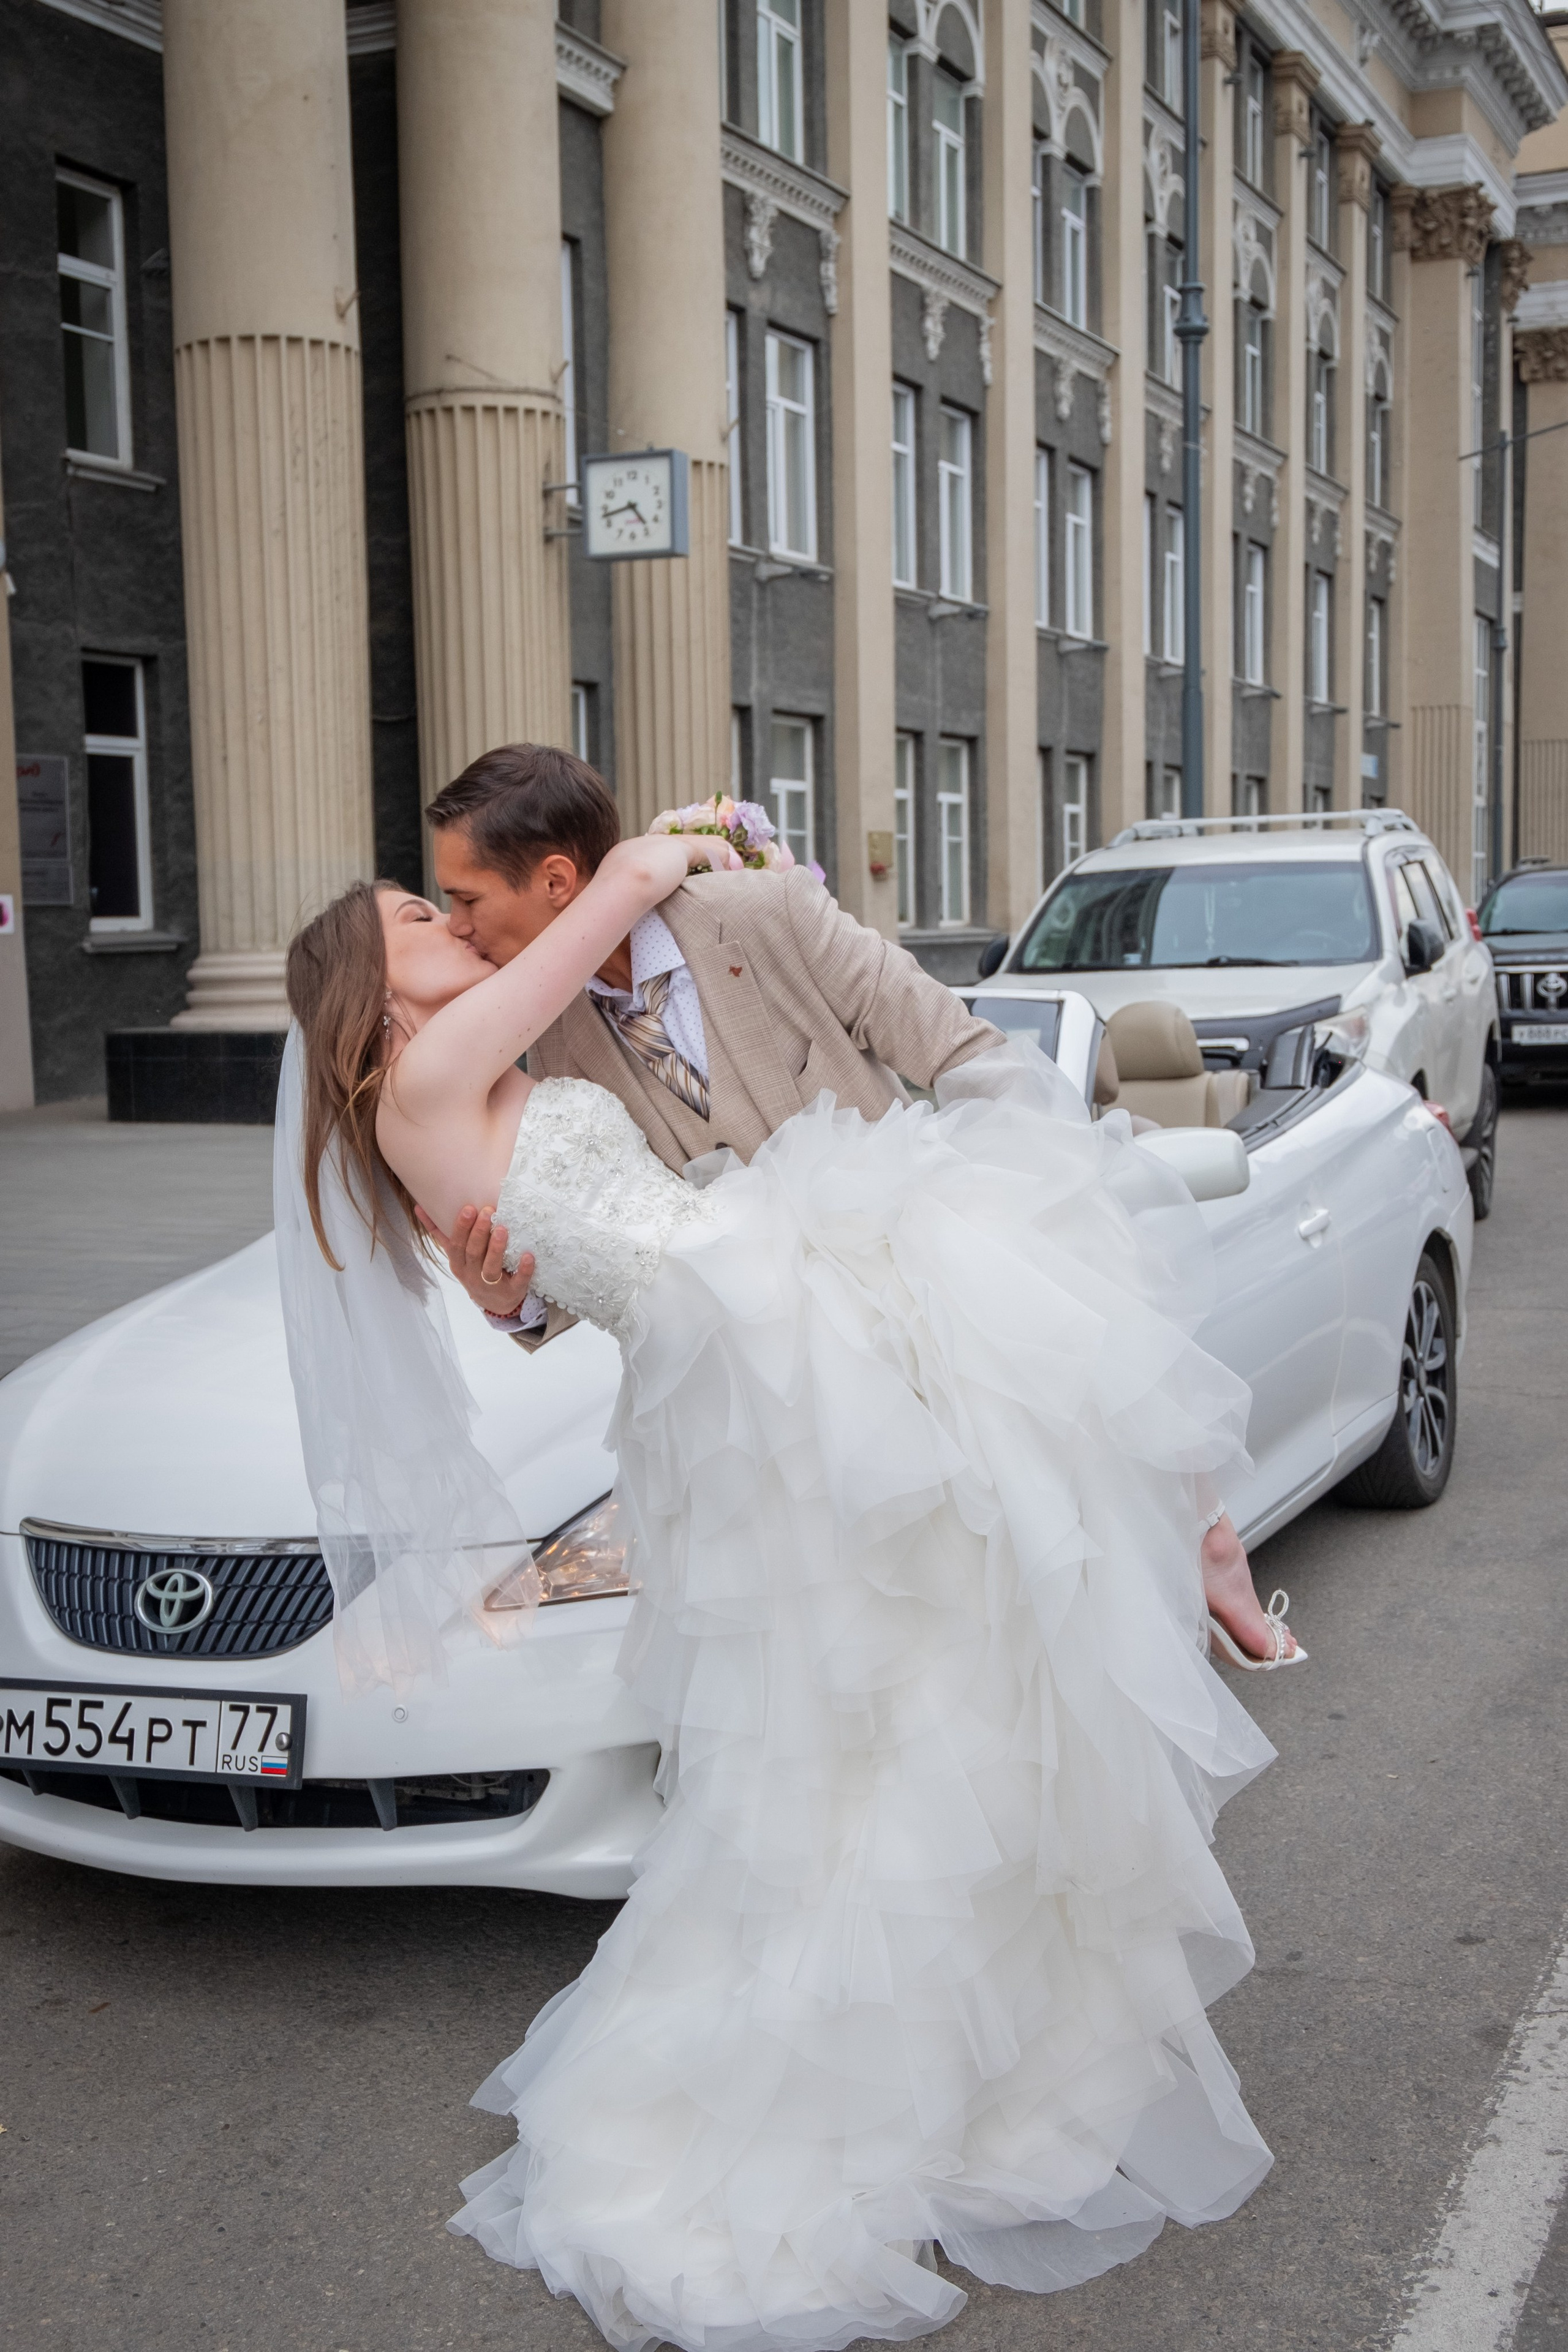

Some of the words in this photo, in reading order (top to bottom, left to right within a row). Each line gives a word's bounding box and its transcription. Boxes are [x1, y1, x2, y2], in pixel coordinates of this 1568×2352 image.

[627, 470, 638, 480] 12
[613, 478, 623, 487] 11
[605, 490, 615, 499] 10
[0, 1697, 207, 1766] М554РТ
[229, 1704, 278, 1752] 77
[222, 1754, 258, 1772] RUS
